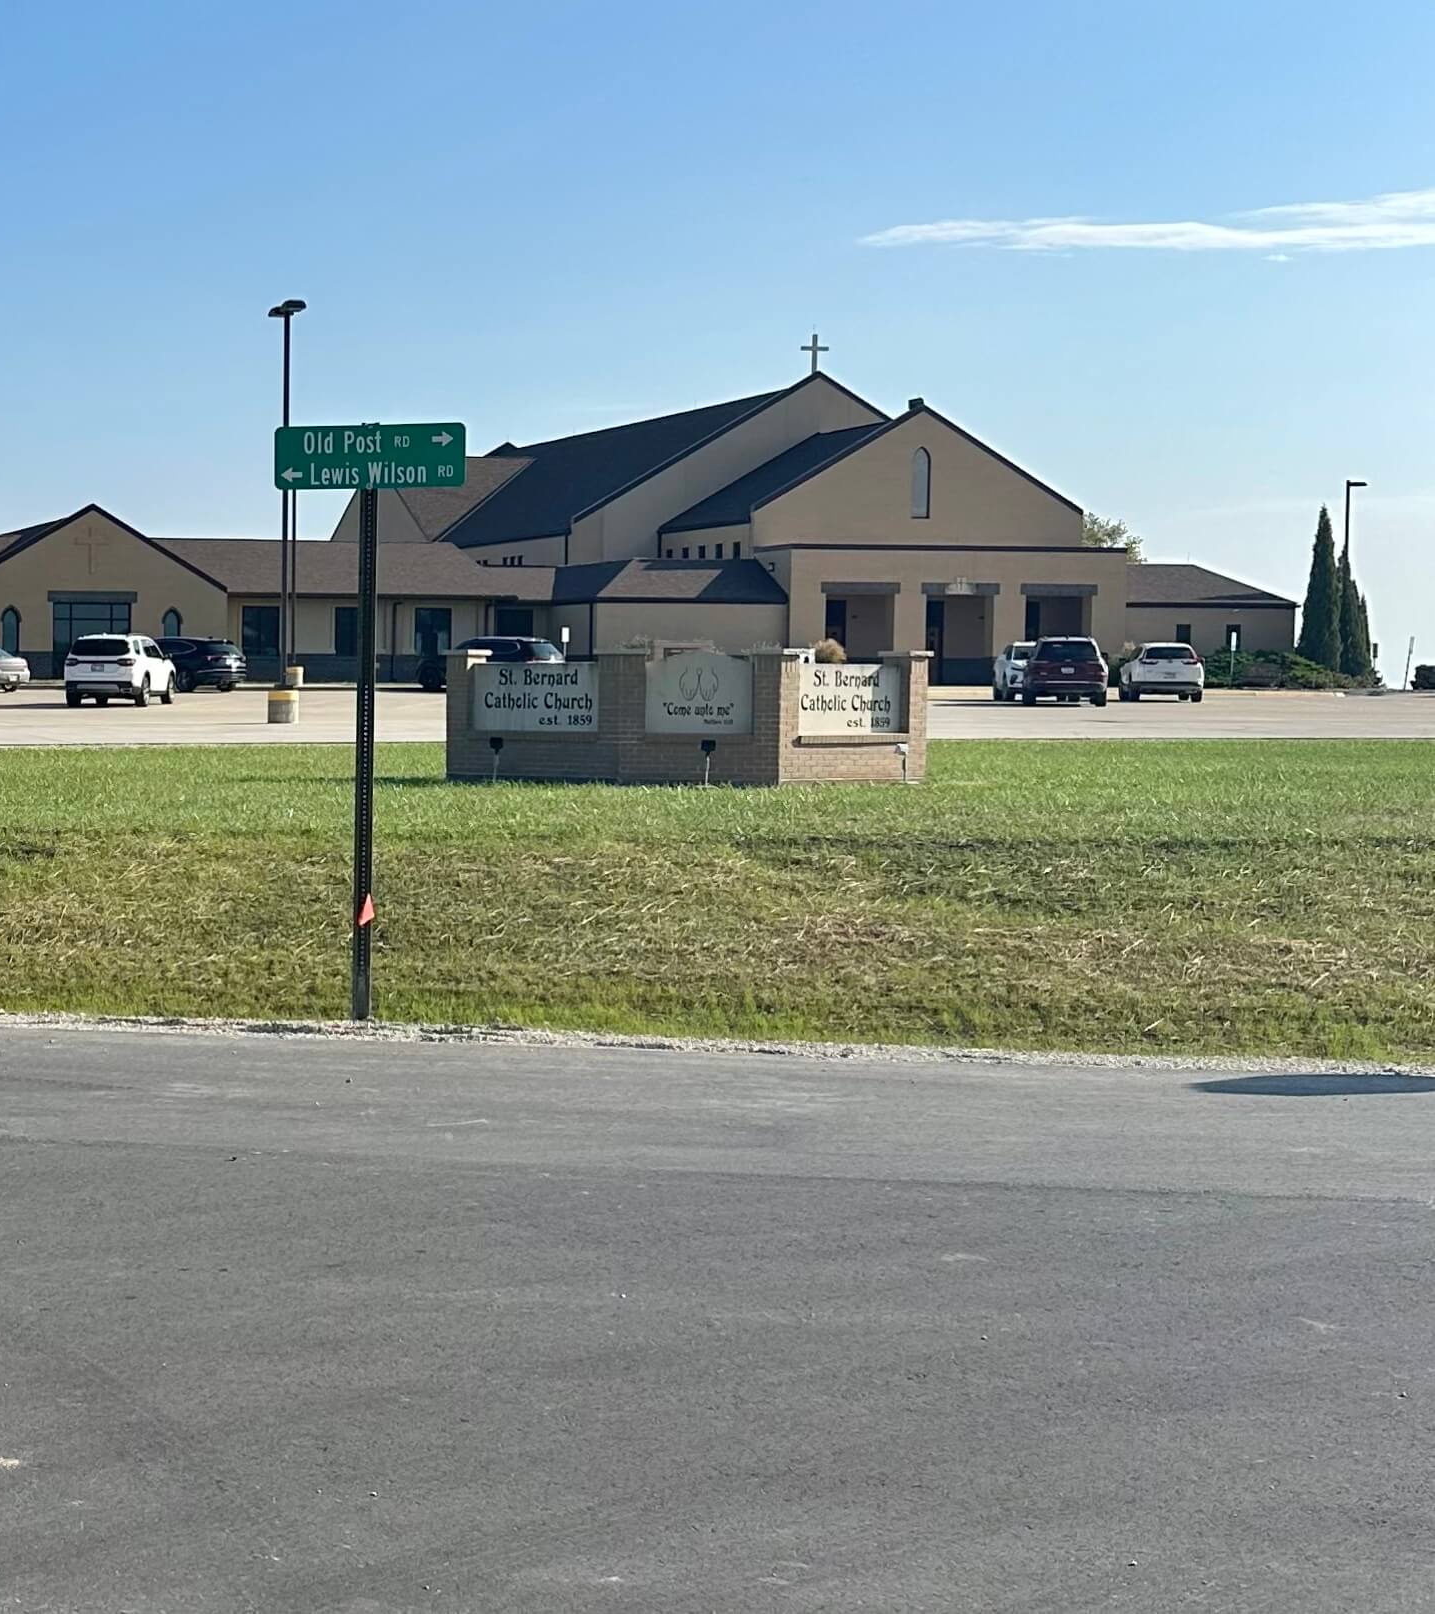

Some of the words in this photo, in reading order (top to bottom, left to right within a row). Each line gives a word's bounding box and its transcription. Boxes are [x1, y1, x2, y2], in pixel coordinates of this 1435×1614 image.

[303, 431, 333, 455] Old
[344, 430, 382, 454] Post
[394, 435, 410, 448] RD
[310, 462, 359, 485] Lewis
[368, 461, 426, 484] Wilson
[438, 465, 453, 477] RD
[499, 668, 517, 686] St.
[524, 668, 578, 687] Bernard
[813, 669, 829, 687] St.
[835, 670, 880, 690] Bernard
[484, 692, 538, 711] Catholic
[544, 692, 593, 711] Church
[801, 694, 847, 714] Catholic
[851, 694, 891, 714] Church
[567, 714, 592, 726] 1859
[846, 718, 866, 728] est.
[871, 716, 890, 728] 1859
